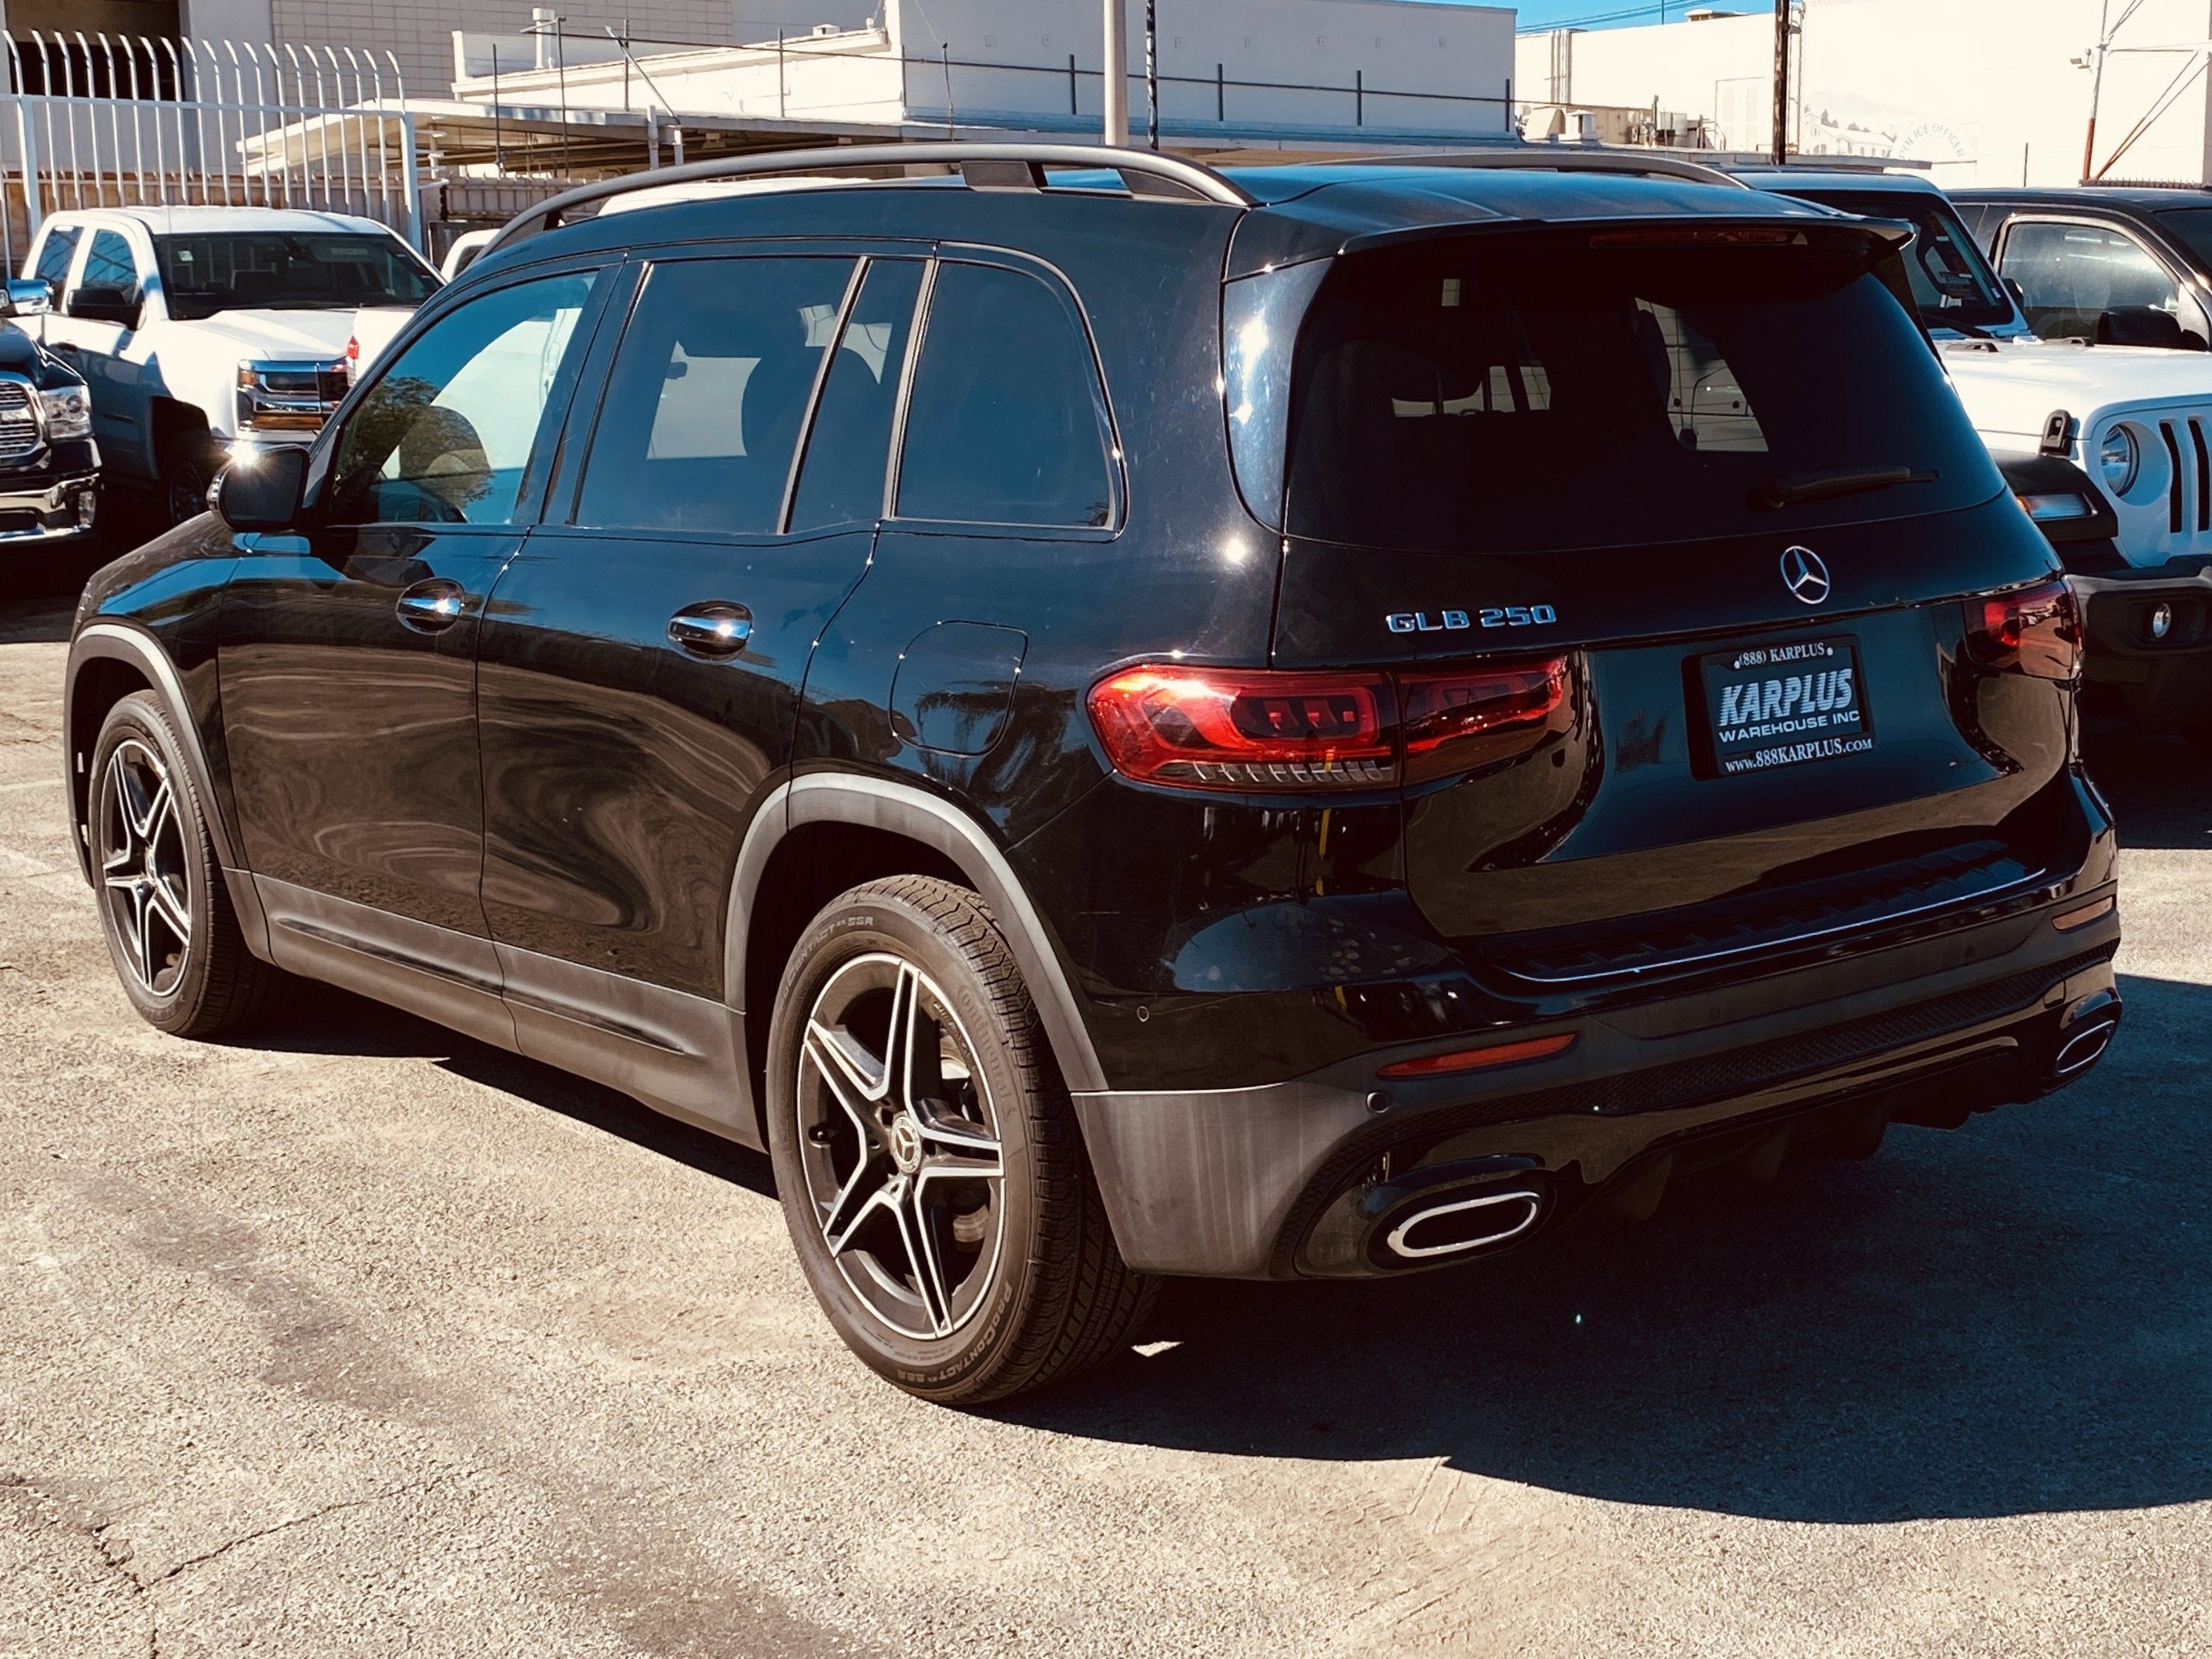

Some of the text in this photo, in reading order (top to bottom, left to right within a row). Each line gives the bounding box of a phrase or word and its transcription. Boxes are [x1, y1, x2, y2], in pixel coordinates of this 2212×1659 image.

[1899, 122, 1964, 159] POLICE OFFICER
[1386, 605, 1557, 632] GLB 250
[1738, 642, 1825, 667] (888) KARPLUS
[1718, 668, 1852, 727] KARPLUS
[1718, 710, 1861, 742] WAREHOUSE INC
[848, 916, 874, 927] SSR
